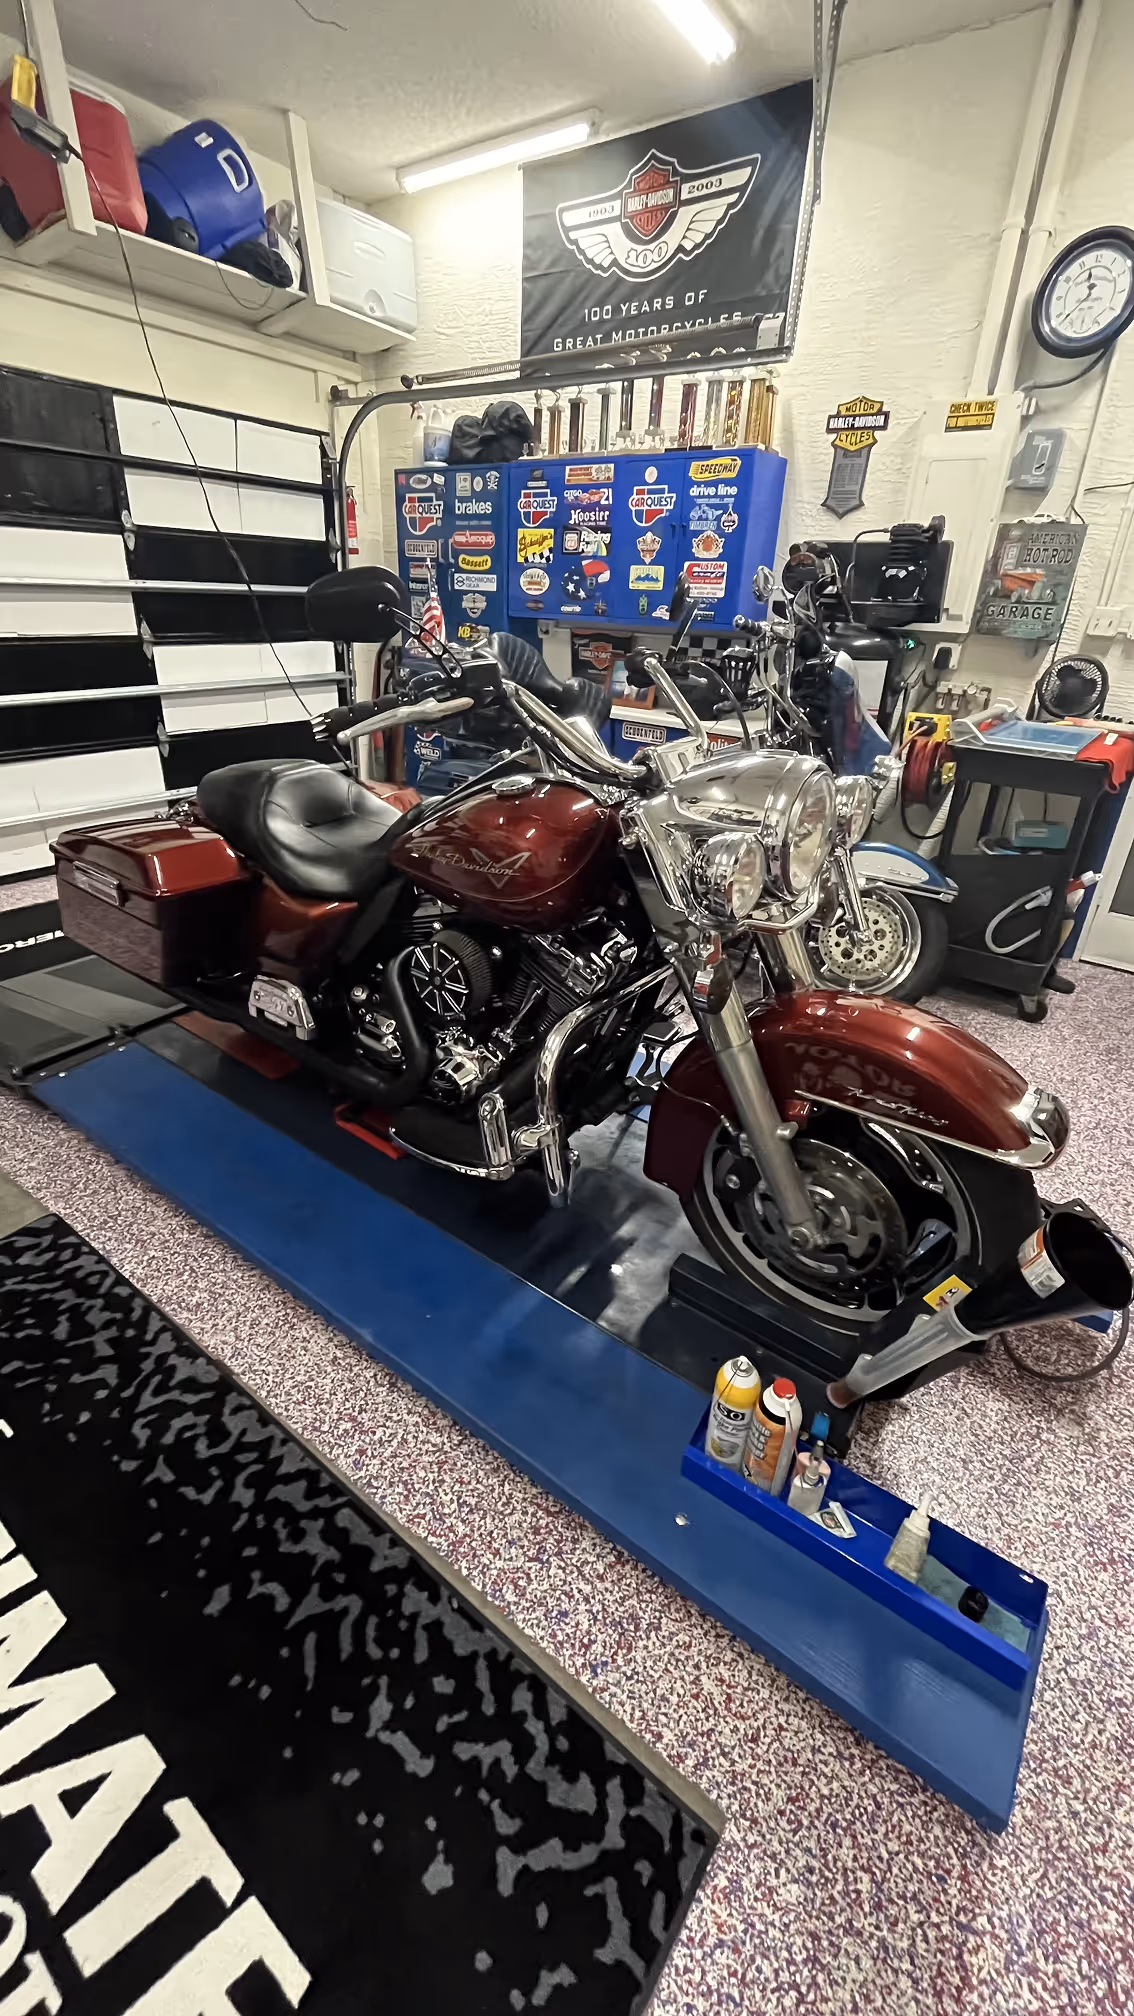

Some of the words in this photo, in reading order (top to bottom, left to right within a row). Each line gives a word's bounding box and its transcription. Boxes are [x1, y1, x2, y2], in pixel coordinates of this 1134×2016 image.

[687, 178, 723, 195] 2003
[588, 204, 615, 219] 1903
[625, 241, 668, 269] 100
[584, 305, 612, 322] 100
[620, 296, 674, 316] YEARS
[684, 290, 708, 306] OF
[553, 334, 602, 351] GREAT
[845, 399, 875, 413] MOTOR
[949, 402, 971, 413] CHECK
[973, 400, 996, 412] TWICE
[829, 415, 885, 429] HARLEY-DAVIDSON
[838, 431, 871, 446] CYCLES
[699, 462, 738, 475] SPEEDWAY
[600, 488, 613, 505] 21
[690, 485, 716, 496] drive
[717, 484, 738, 495] line
[455, 498, 492, 515] brakes
[519, 499, 556, 511] CARQUEST
[630, 495, 675, 508] CARQUEST
[404, 503, 442, 517] CARQUEST
[568, 507, 610, 525] Hoosier
[580, 530, 611, 545] Racing
[1028, 533, 1080, 545] AMERICAN
[579, 541, 597, 554] Fuel
[460, 557, 489, 568] Bassett
[1023, 548, 1049, 563] HOT
[1049, 548, 1074, 563] ROD
[985, 603, 1055, 621] GARAGE
[458, 626, 470, 638] KB
